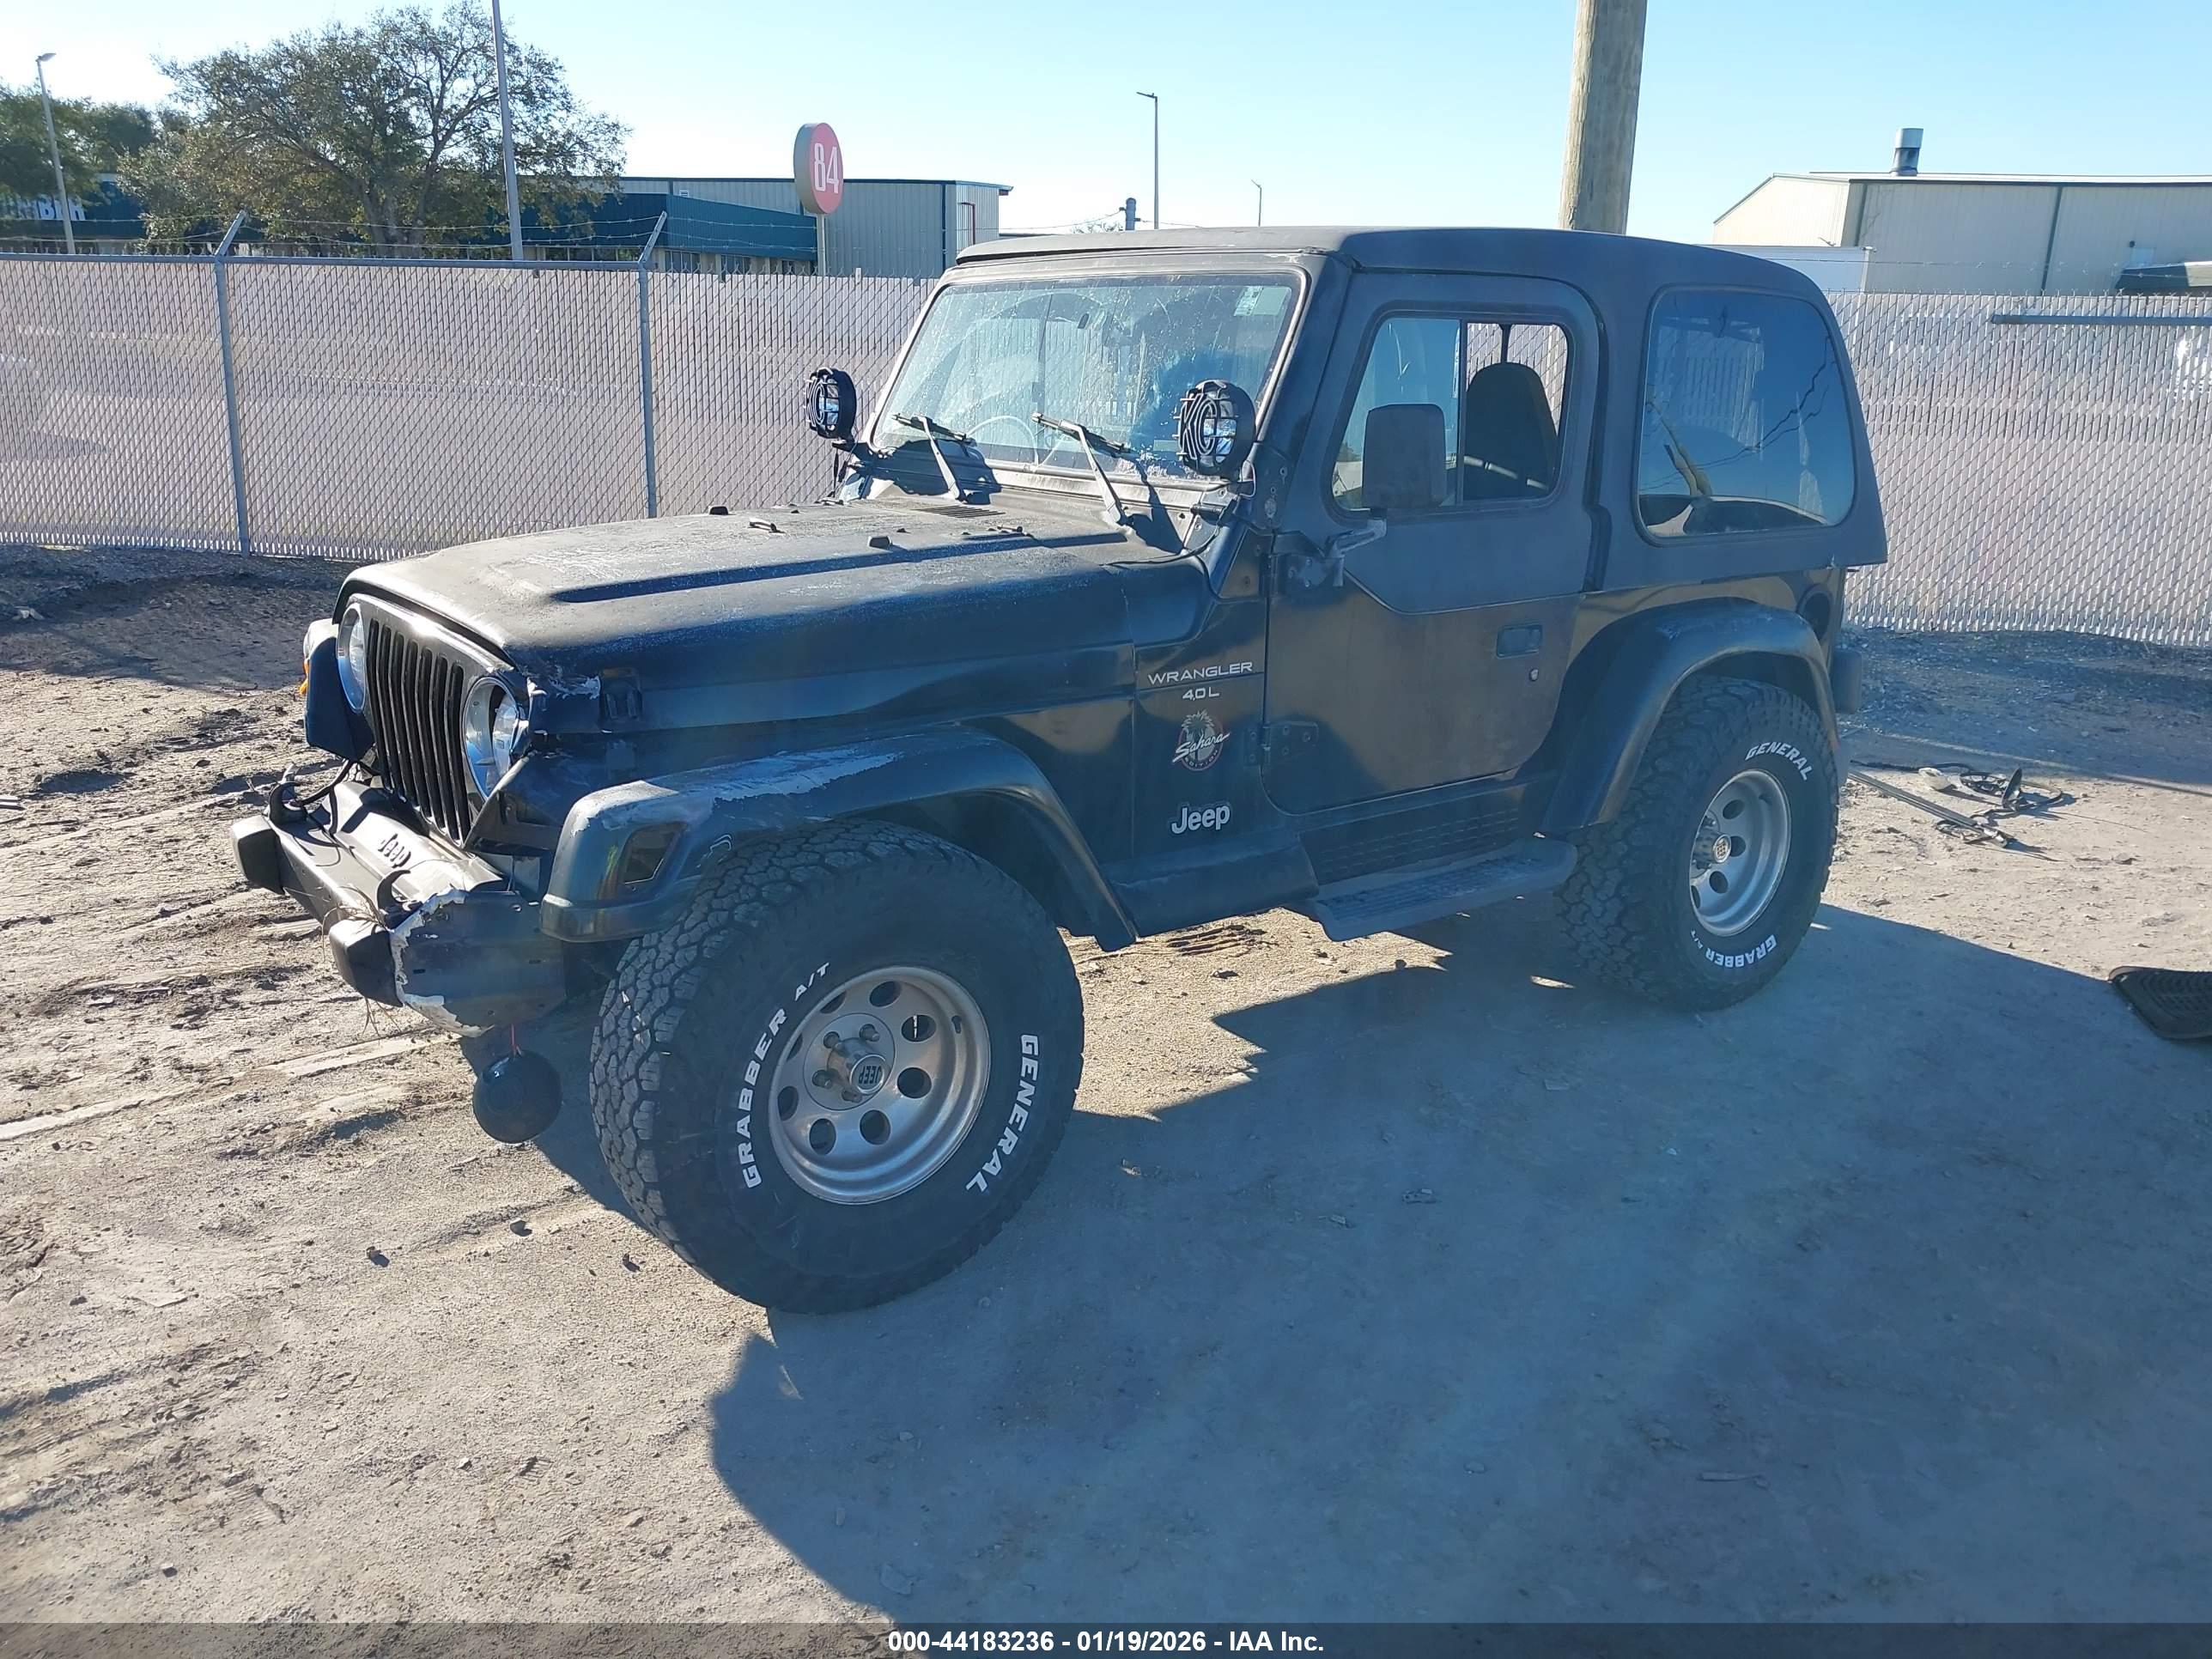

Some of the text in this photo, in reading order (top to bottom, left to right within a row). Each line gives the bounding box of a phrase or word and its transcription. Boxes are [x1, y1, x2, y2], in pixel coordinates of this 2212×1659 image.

[814, 143, 840, 194] 84
[1178, 393, 1218, 459] KC
[1148, 661, 1253, 685] WRANGLER
[1172, 732, 1231, 763] Sahara
[1744, 741, 1814, 781] GENERAL
[1171, 805, 1231, 835] Jeep
[1705, 934, 1777, 968] GRABBER
[736, 962, 830, 1188] GRABBER A/T
[859, 1066, 882, 1084] JEEP
[966, 1034, 1040, 1193] GENERAL
